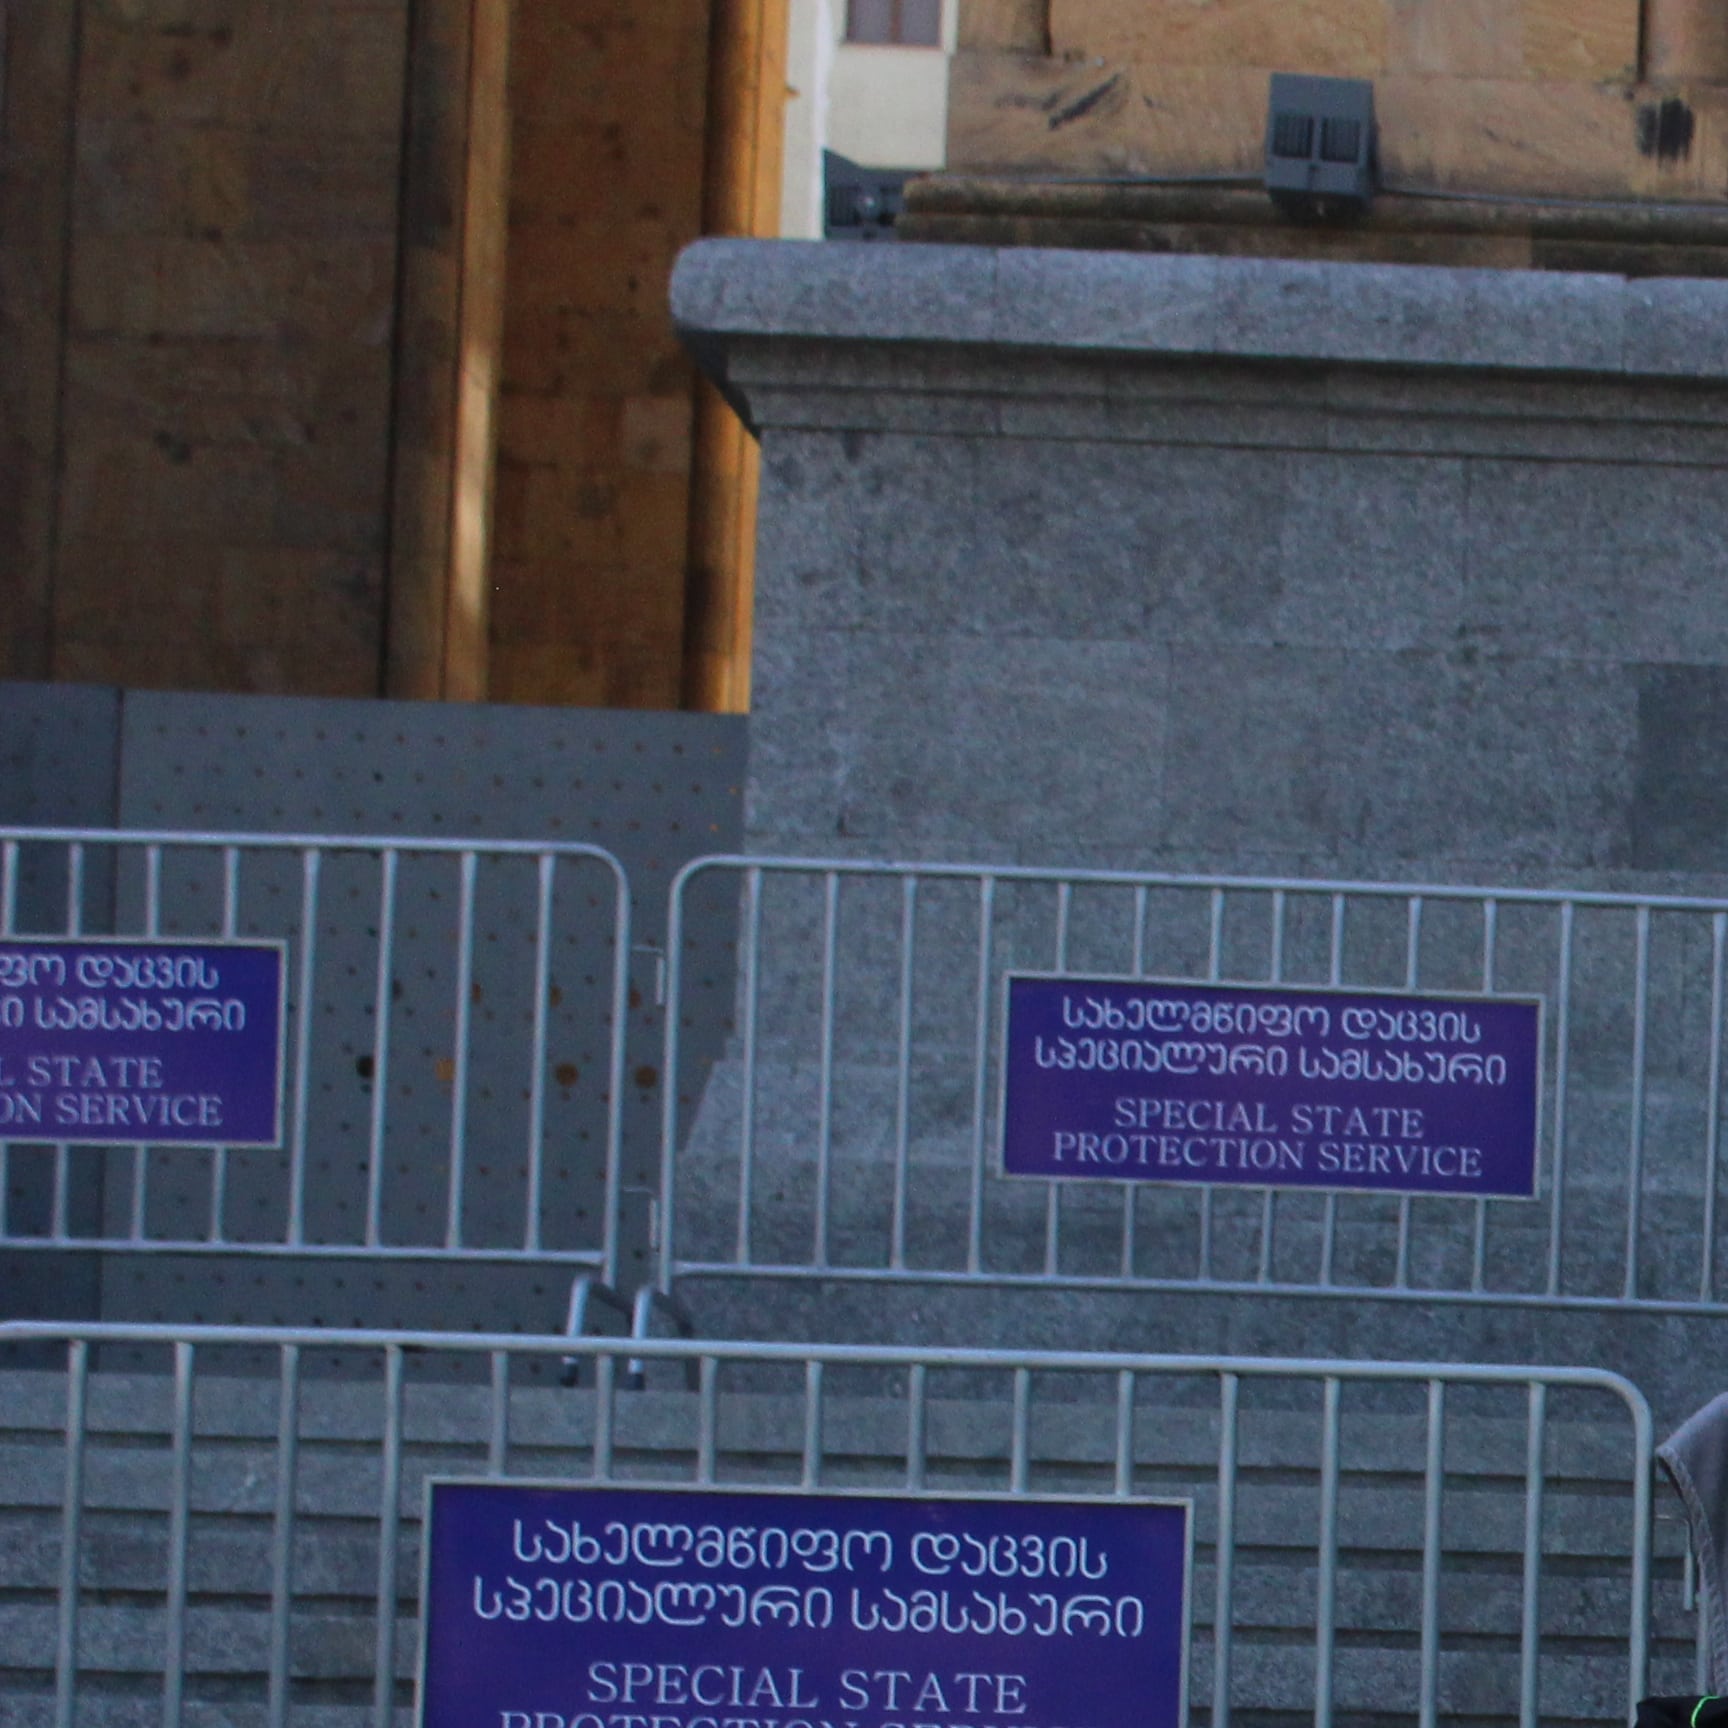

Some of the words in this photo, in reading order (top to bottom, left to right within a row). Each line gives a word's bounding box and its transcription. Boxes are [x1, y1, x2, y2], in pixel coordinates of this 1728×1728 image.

[77, 956, 218, 989] დაცვის
[36, 997, 245, 1030] სამსახური
[1064, 997, 1330, 1036] სახელმწიფო
[1342, 1008, 1480, 1043] დაცვის
[29, 1056, 161, 1088] STATE
[1036, 1033, 1289, 1075] სპეციალური
[1300, 1048, 1505, 1084] სამსახური
[57, 1094, 222, 1125] SERVICE
[1115, 1099, 1276, 1132] SPECIAL
[1292, 1106, 1422, 1138] STATE
[1055, 1130, 1303, 1168] PROTECTION
[1319, 1143, 1480, 1176] SERVICE
[515, 1520, 892, 1571] სახელმწიფო
[912, 1533, 1107, 1579] დაცვის
[475, 1576, 832, 1627] სპეციალური
[852, 1589, 1143, 1636] სამსახური
[589, 1664, 817, 1707] SPECIAL
[840, 1671, 1025, 1713] STATE
